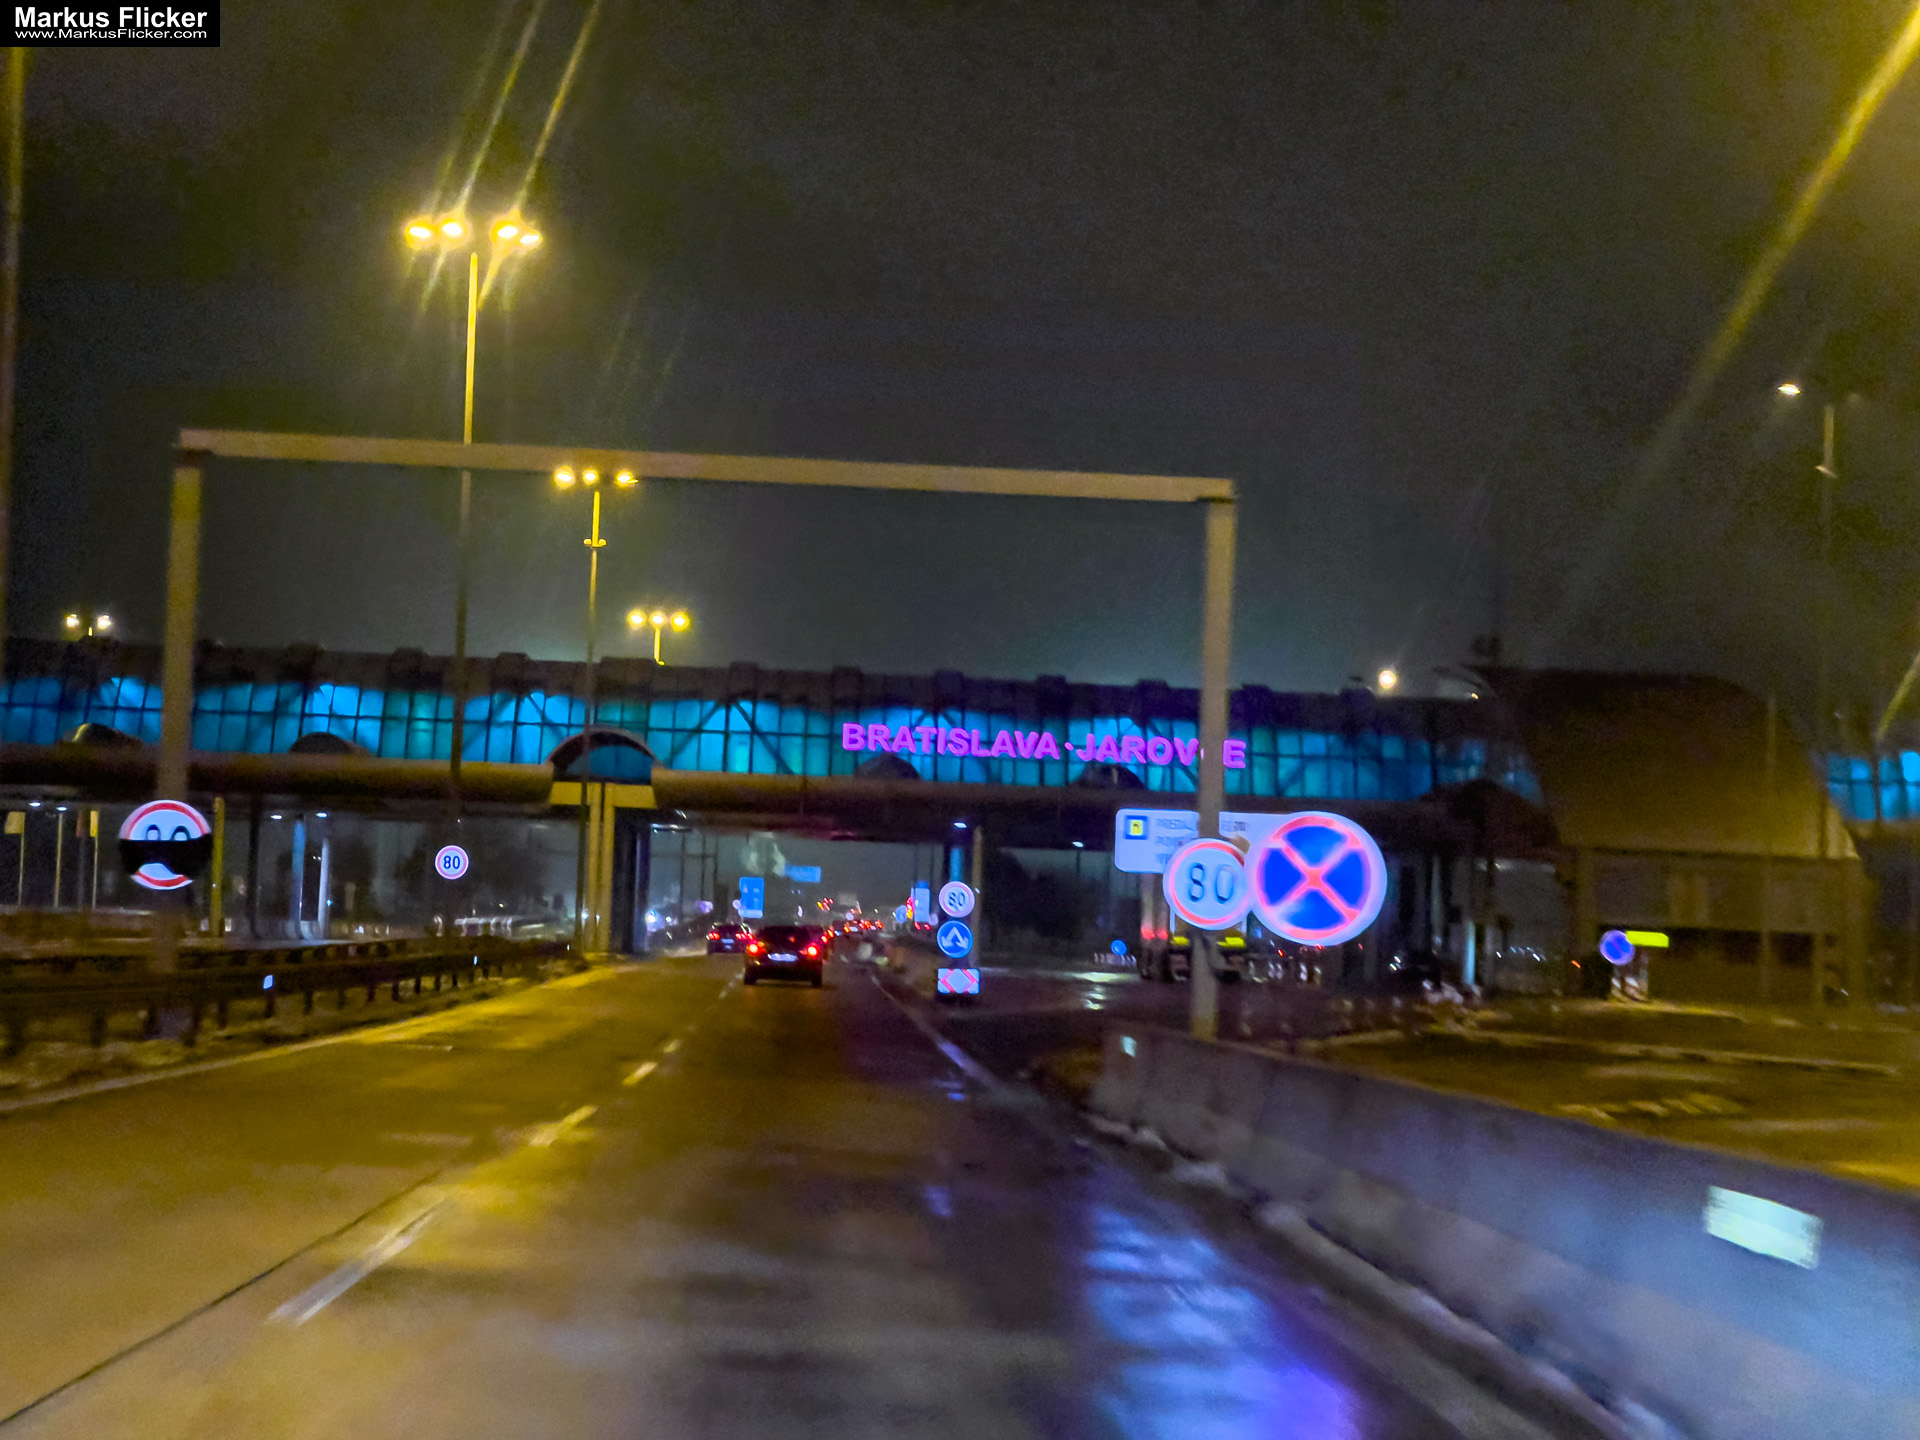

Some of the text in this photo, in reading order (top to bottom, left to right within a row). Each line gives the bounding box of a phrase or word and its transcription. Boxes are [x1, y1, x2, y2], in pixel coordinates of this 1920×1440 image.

[842, 722, 1061, 760] BRATISLAVA
[1076, 732, 1247, 769] JAROVE
[443, 855, 461, 870] 80
[1187, 862, 1235, 904] 80
[948, 891, 966, 910] 80
